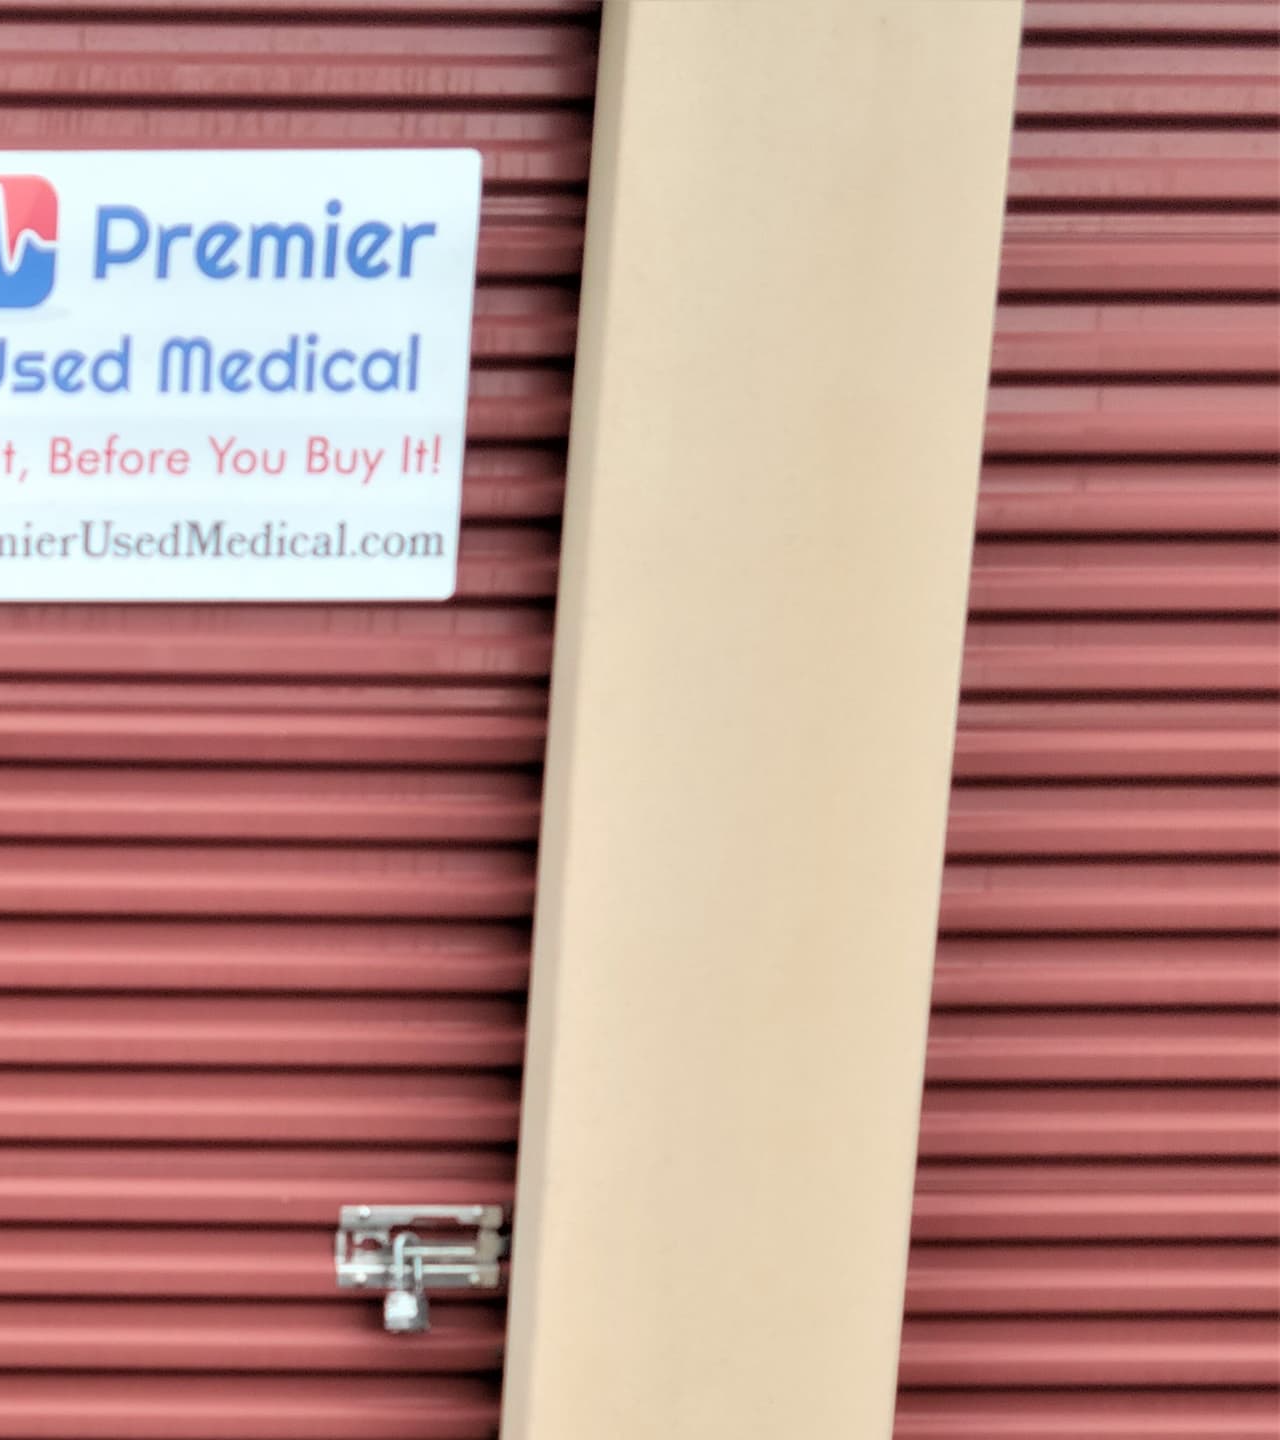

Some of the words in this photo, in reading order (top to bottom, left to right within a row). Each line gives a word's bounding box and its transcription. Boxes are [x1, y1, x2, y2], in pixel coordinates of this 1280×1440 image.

[93, 199, 436, 280] Premier
[159, 333, 419, 394] Medical
[50, 435, 189, 475] Before
[210, 437, 285, 474] You
[307, 436, 383, 483] Buy
[402, 435, 440, 472] It!
